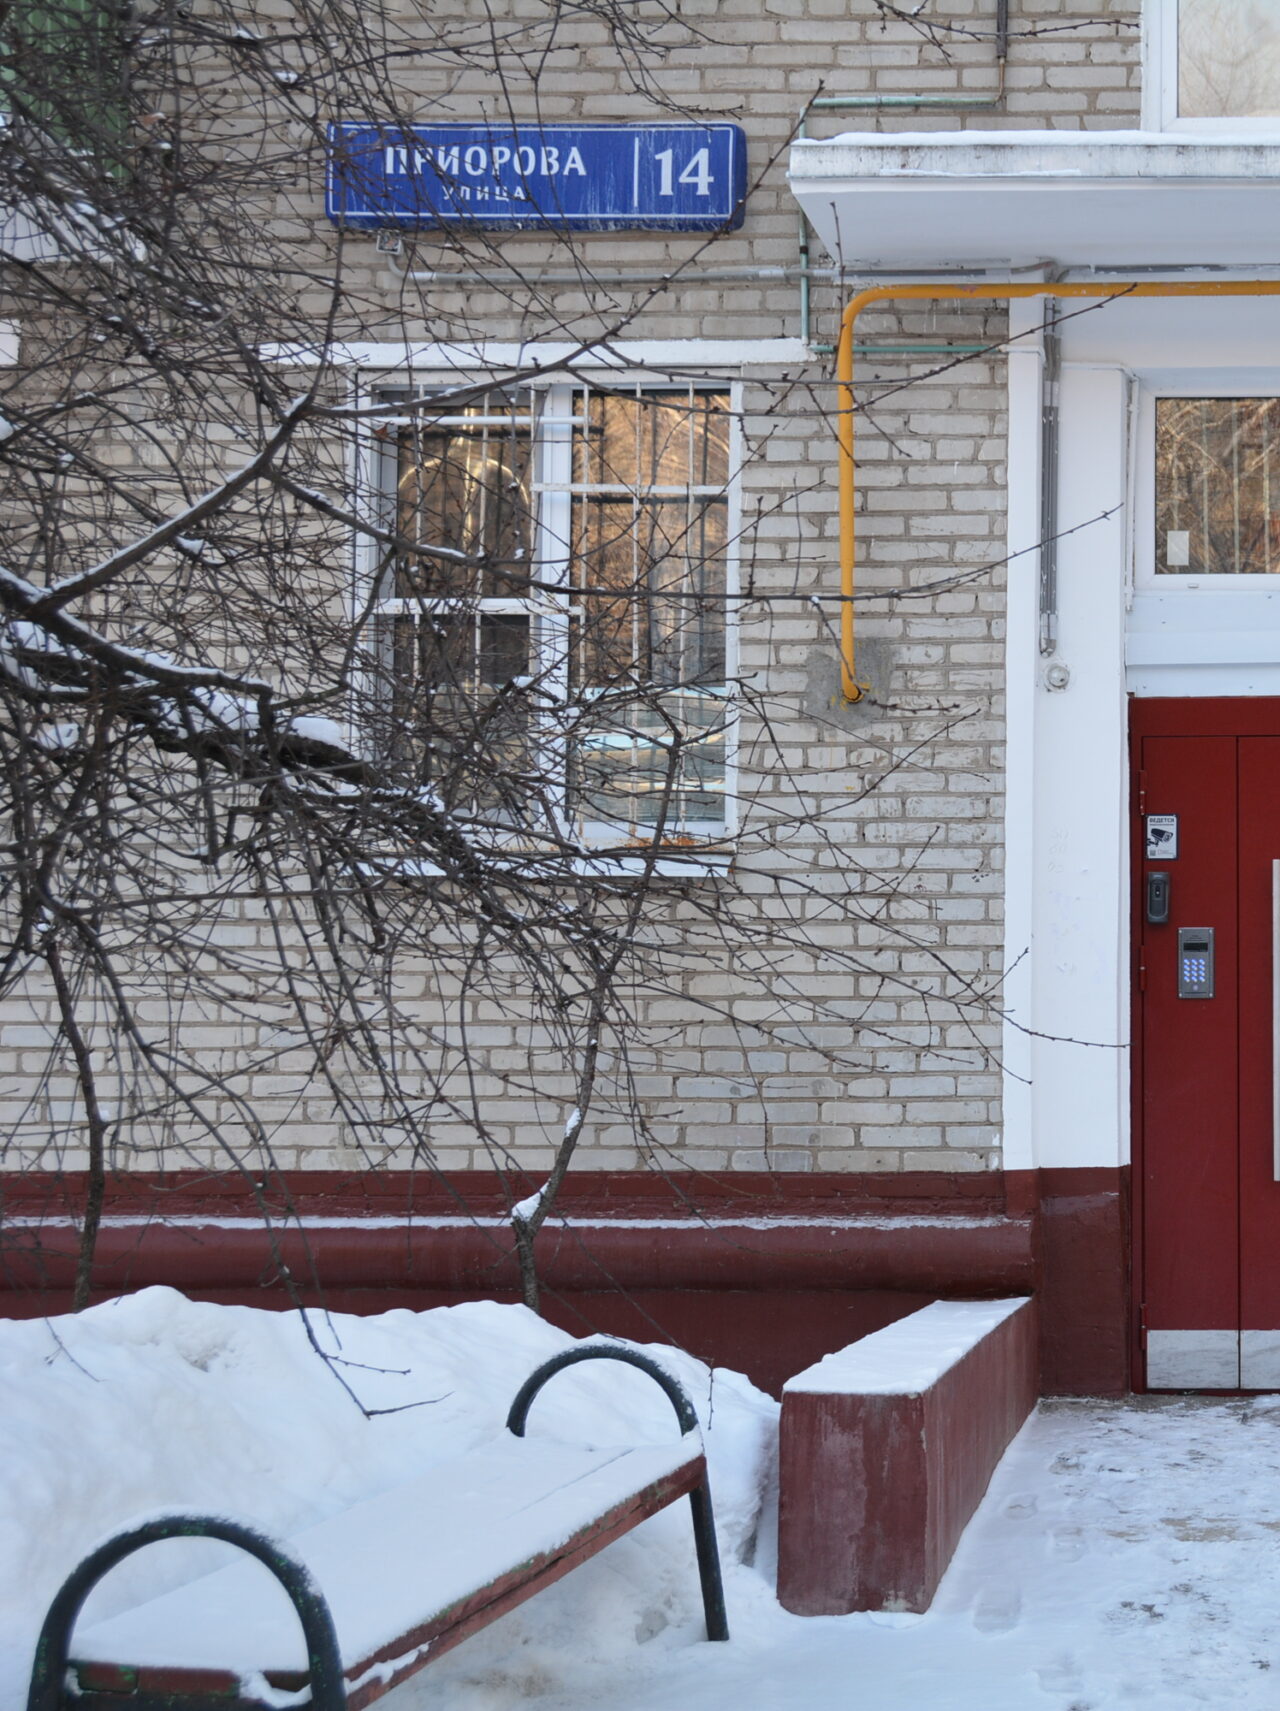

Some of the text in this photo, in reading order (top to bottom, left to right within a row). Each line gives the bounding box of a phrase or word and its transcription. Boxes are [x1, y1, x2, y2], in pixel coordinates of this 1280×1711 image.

[385, 146, 587, 176] ПРИОРОВА
[654, 147, 715, 196] 14
[442, 185, 526, 202] УЛИЦА
